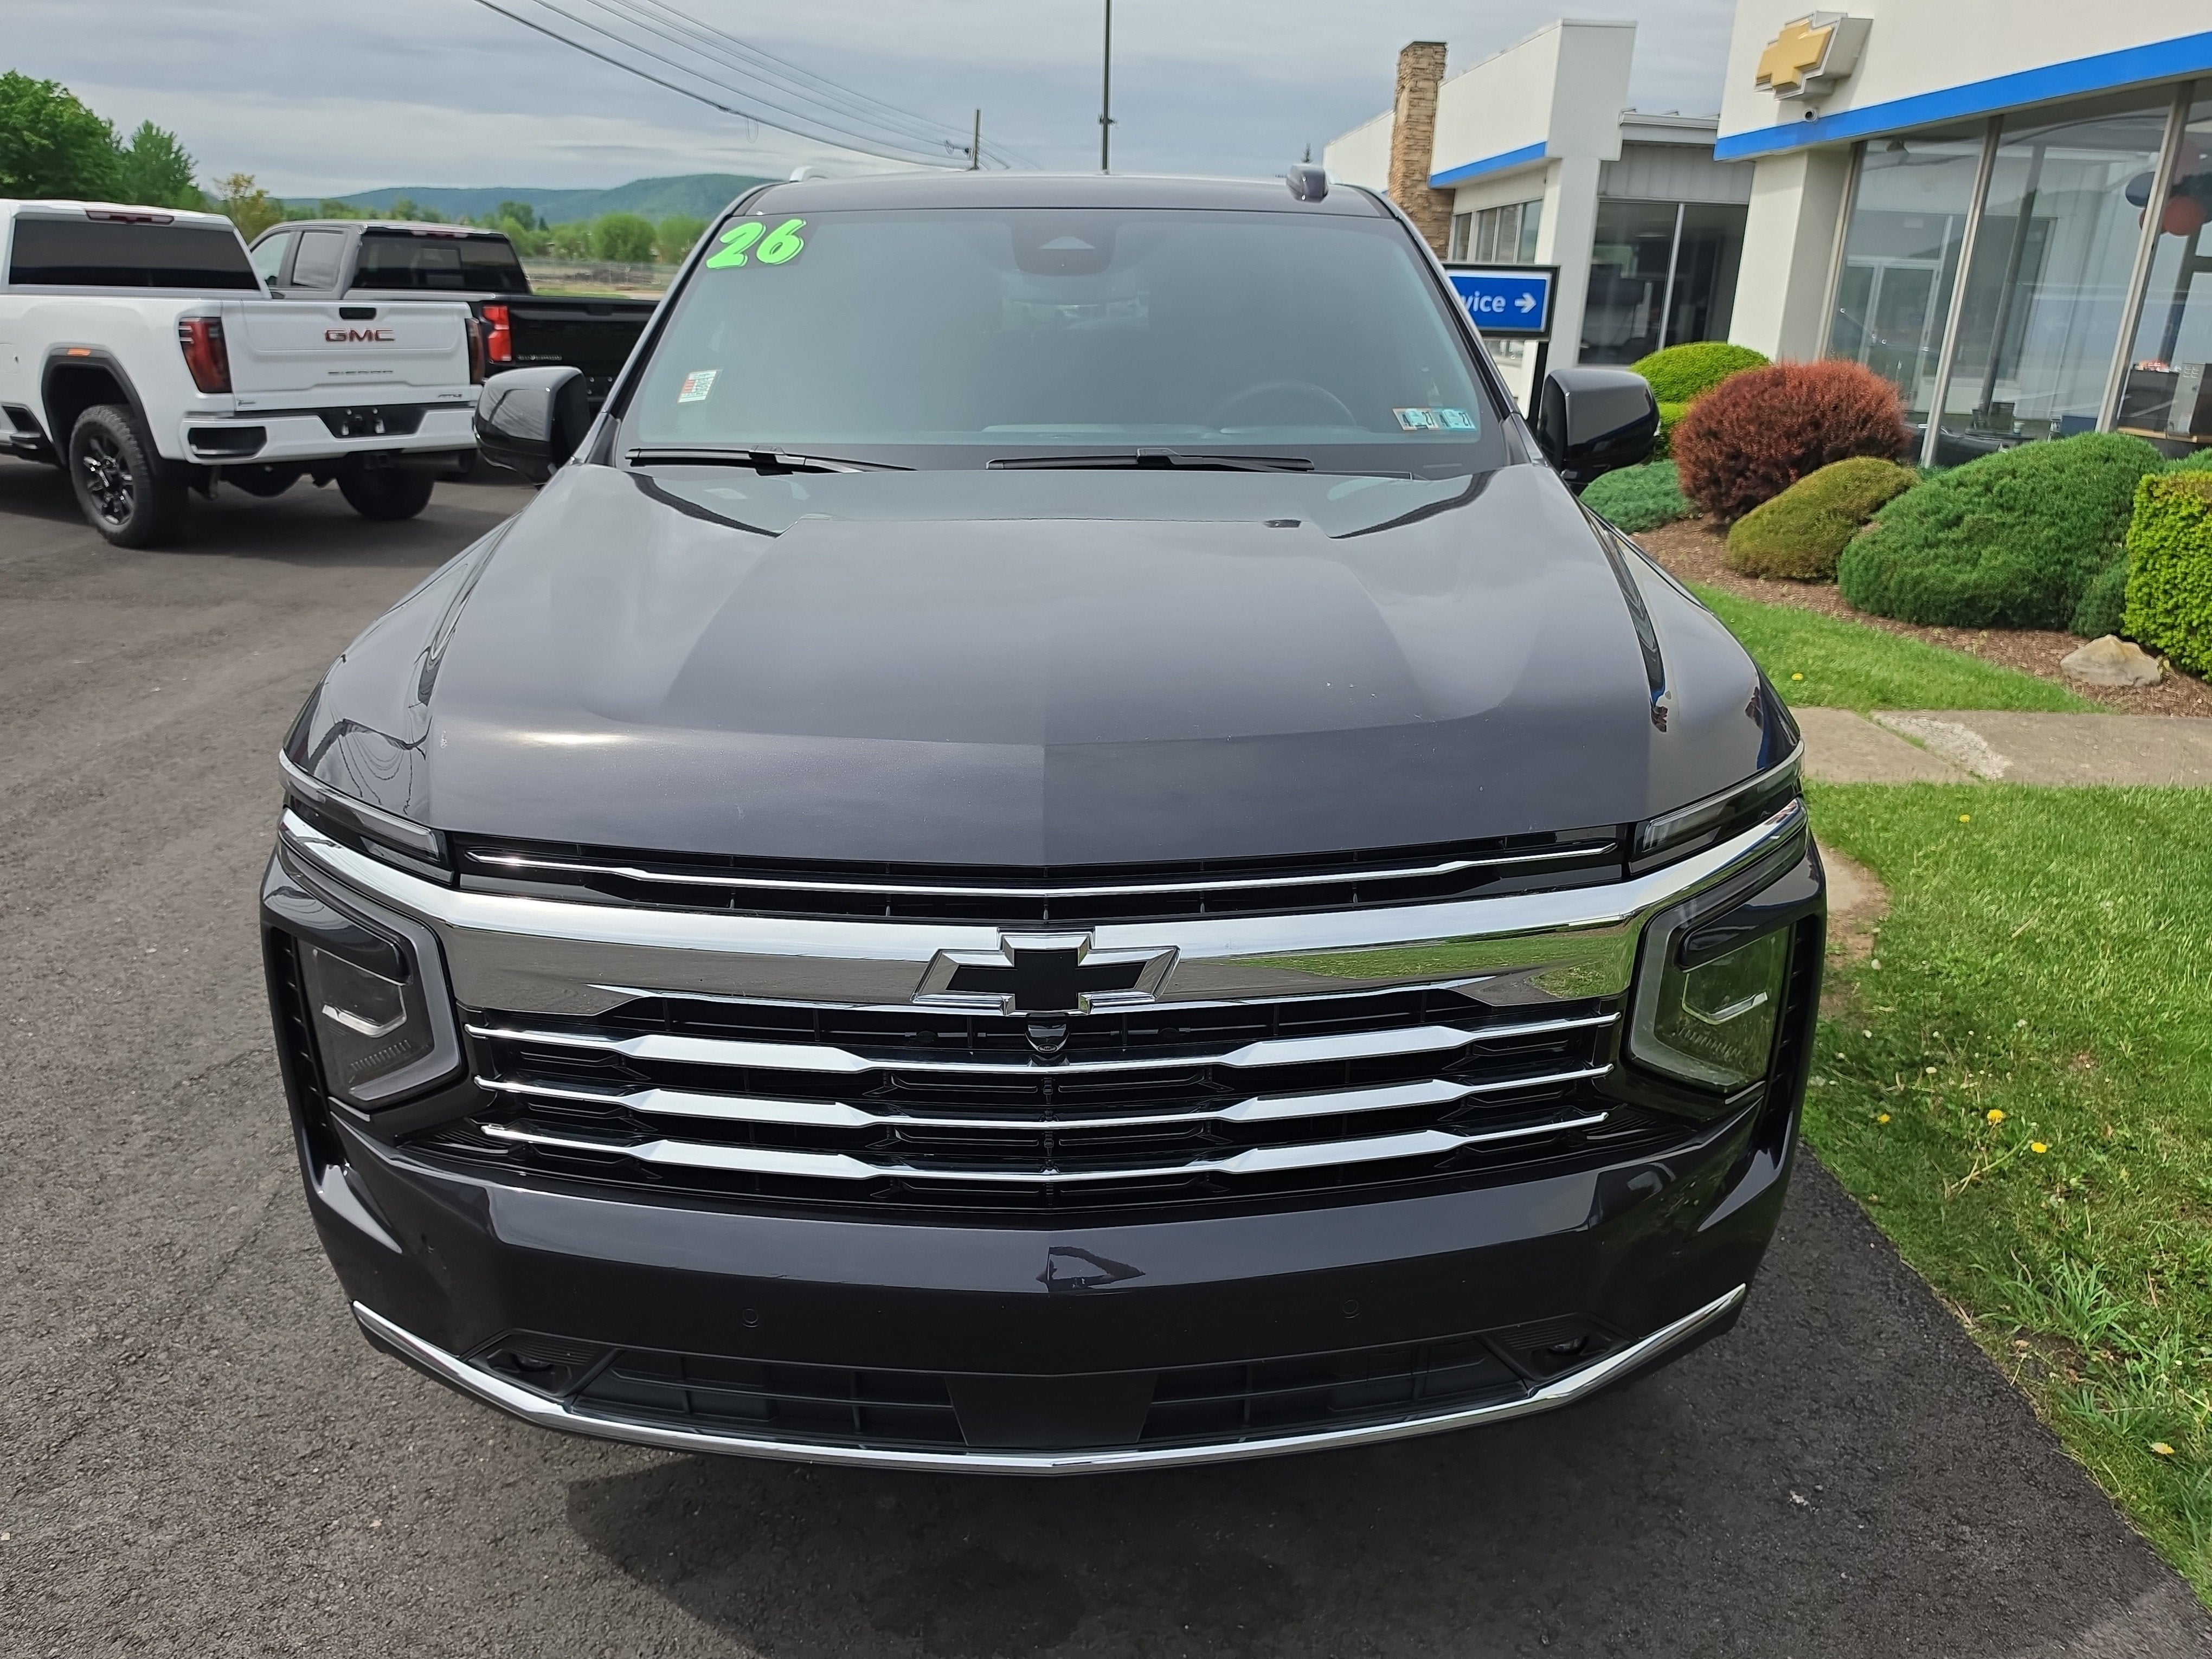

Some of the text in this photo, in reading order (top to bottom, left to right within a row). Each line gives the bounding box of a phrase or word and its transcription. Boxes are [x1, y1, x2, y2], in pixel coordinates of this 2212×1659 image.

[706, 218, 807, 269] 26
[325, 329, 395, 342] GMC
[1422, 411, 1435, 426] 27
[1458, 412, 1471, 426] 27
